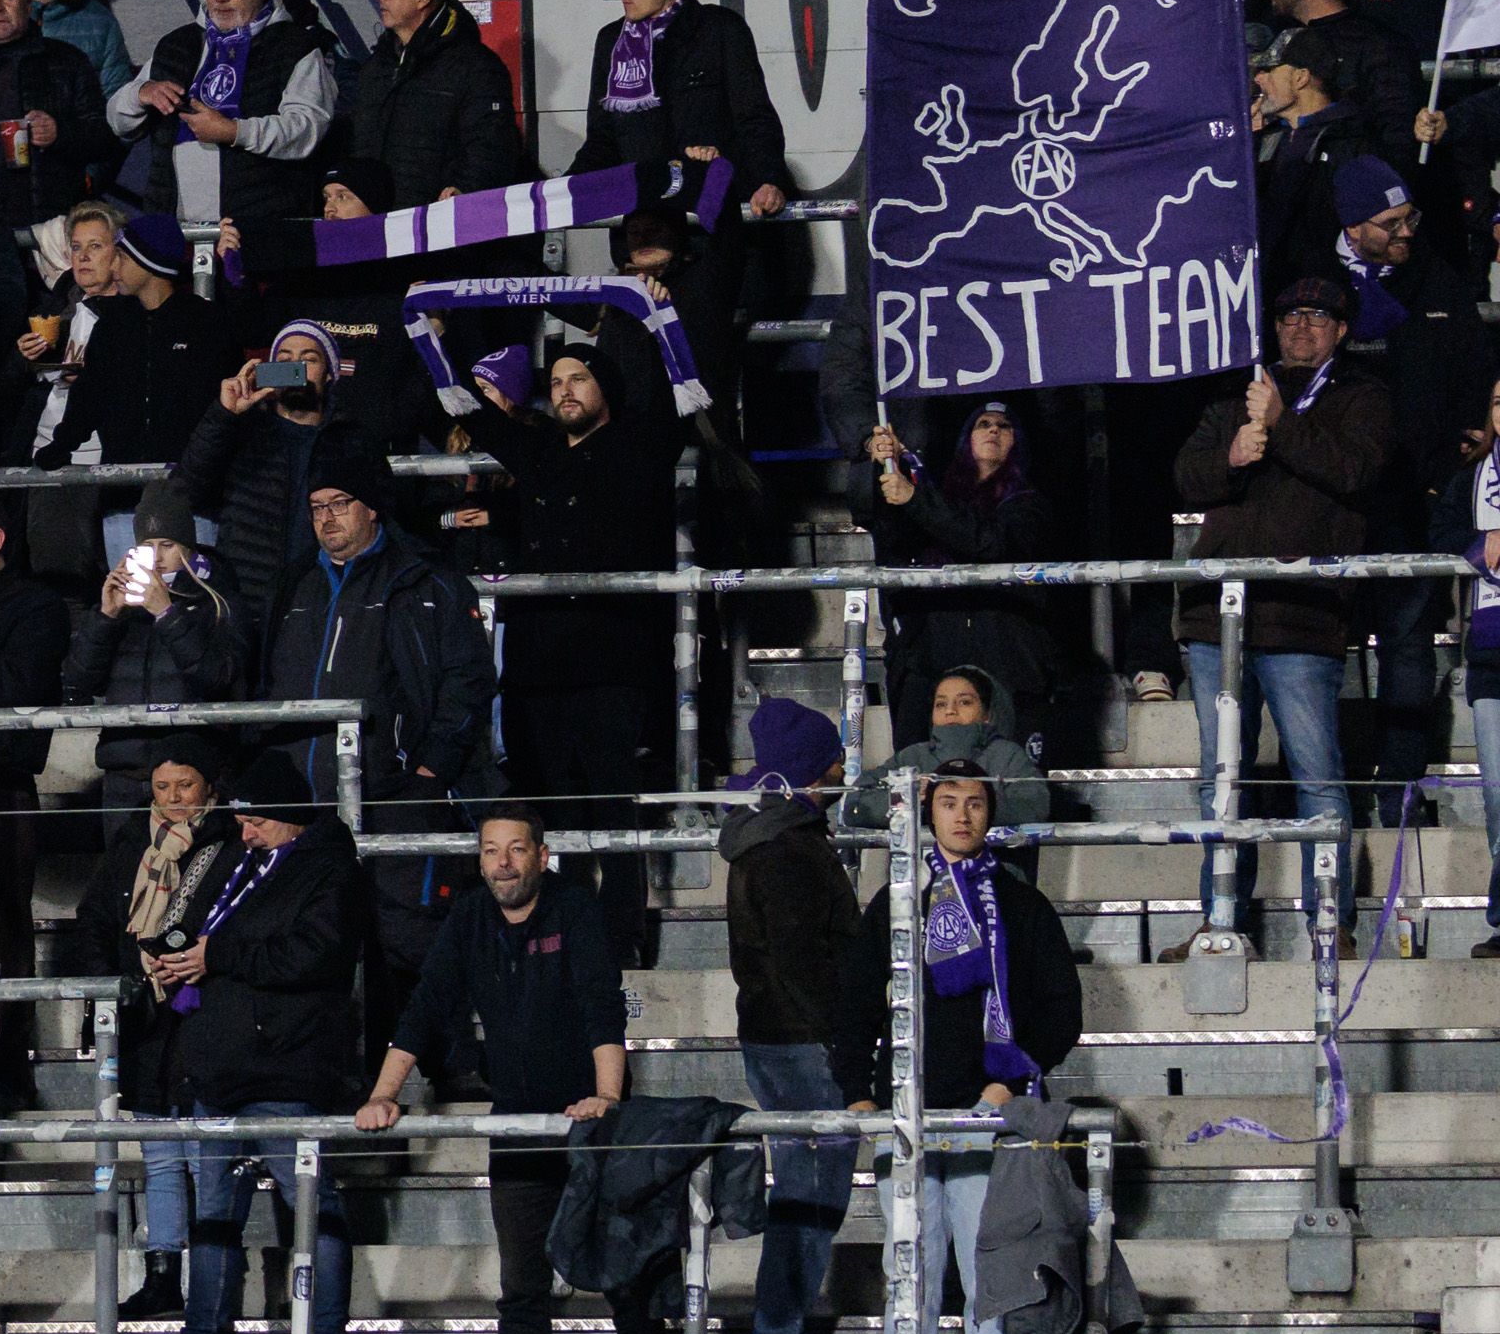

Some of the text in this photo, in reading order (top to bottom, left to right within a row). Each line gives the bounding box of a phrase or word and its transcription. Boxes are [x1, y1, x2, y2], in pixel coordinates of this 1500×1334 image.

[1015, 141, 1073, 198] FAK
[506, 293, 551, 305] WIEN
[874, 256, 1258, 393] BEST TEAM
